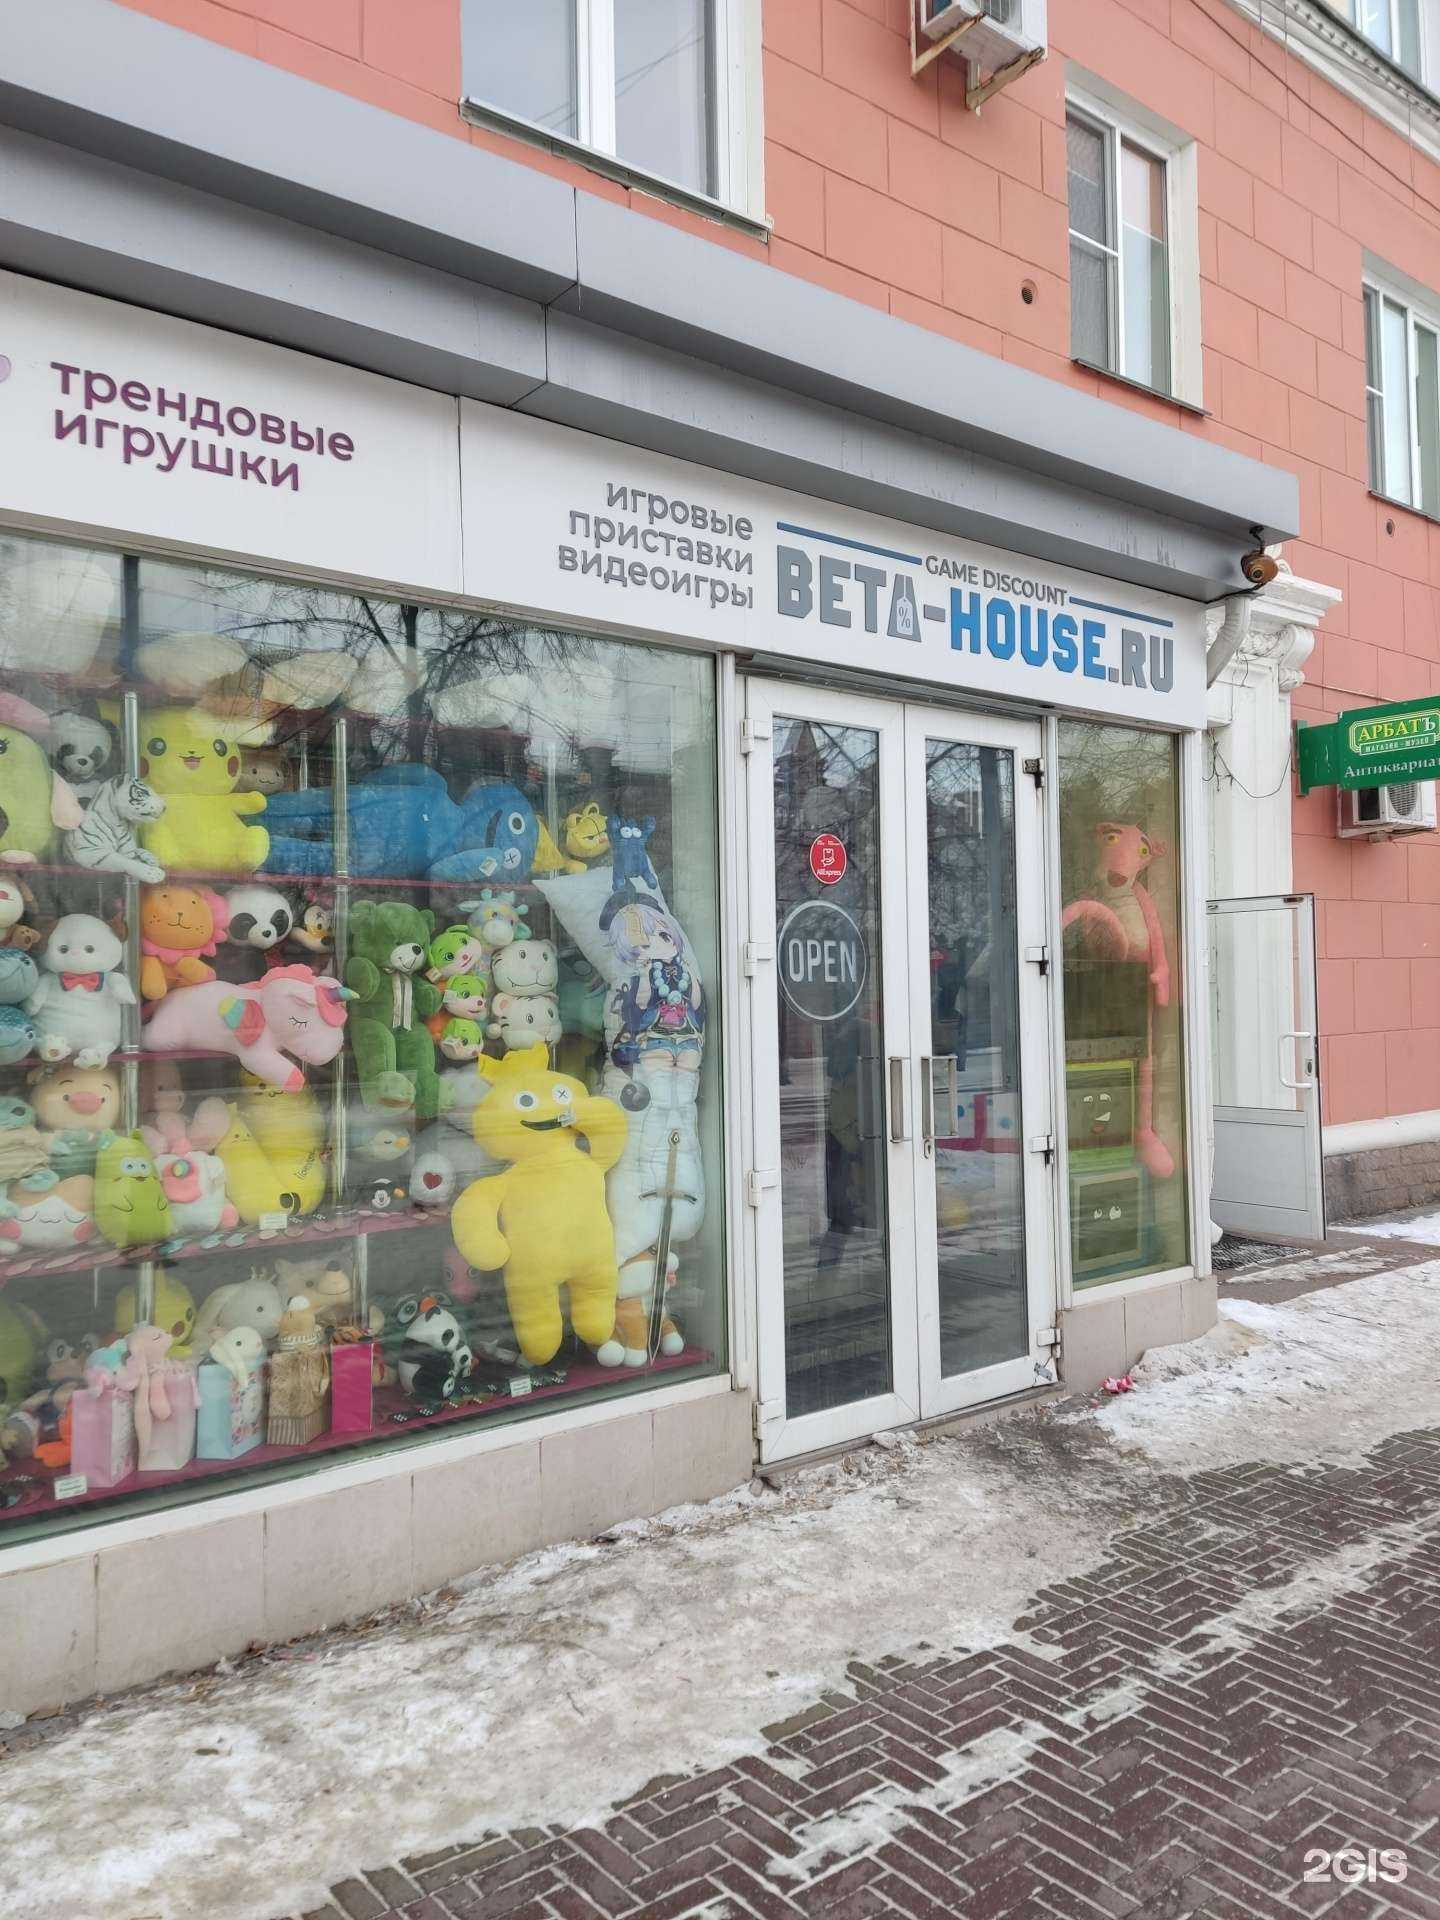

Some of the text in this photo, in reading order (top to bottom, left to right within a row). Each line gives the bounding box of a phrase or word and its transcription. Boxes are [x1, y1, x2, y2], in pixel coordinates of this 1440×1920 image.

[50, 361, 355, 461] трендовые
[54, 409, 300, 491] игрушки
[569, 510, 753, 575] приставки
[606, 482, 754, 541] игровые
[558, 544, 753, 609] видеоигры
[925, 555, 1067, 607] GAME DISCOUNT
[1359, 716, 1436, 741] АРБАТЪ
[788, 937, 857, 983] OPEN
